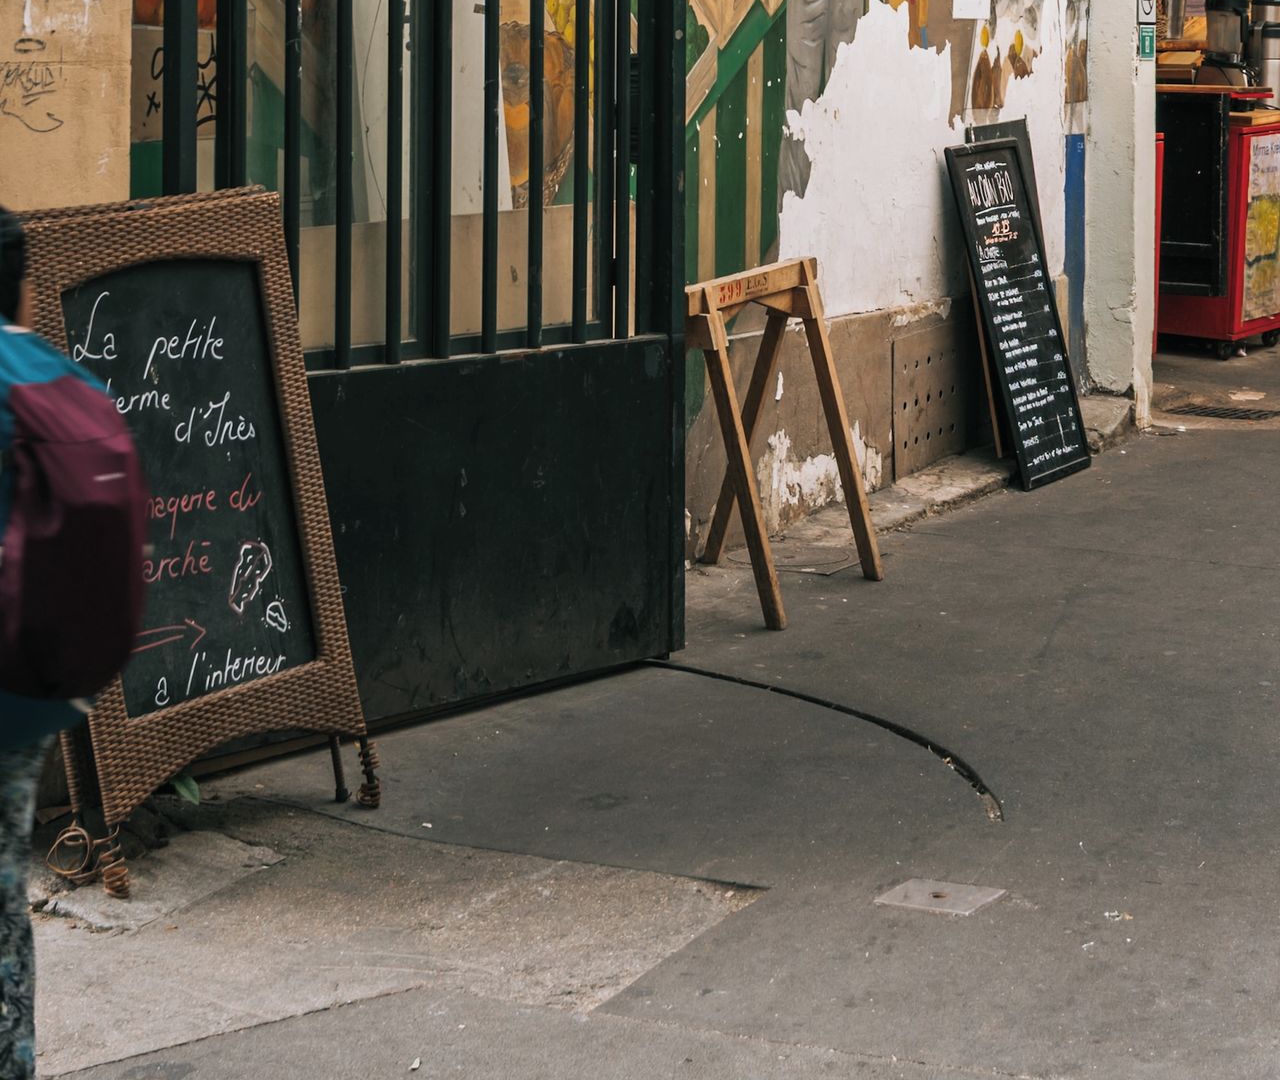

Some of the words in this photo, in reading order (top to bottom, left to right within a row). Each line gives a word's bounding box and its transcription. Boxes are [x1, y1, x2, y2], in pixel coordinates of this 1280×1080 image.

[73, 292, 118, 361] La
[144, 316, 224, 380] petite
[229, 472, 262, 512] du
[142, 540, 213, 583] arché
